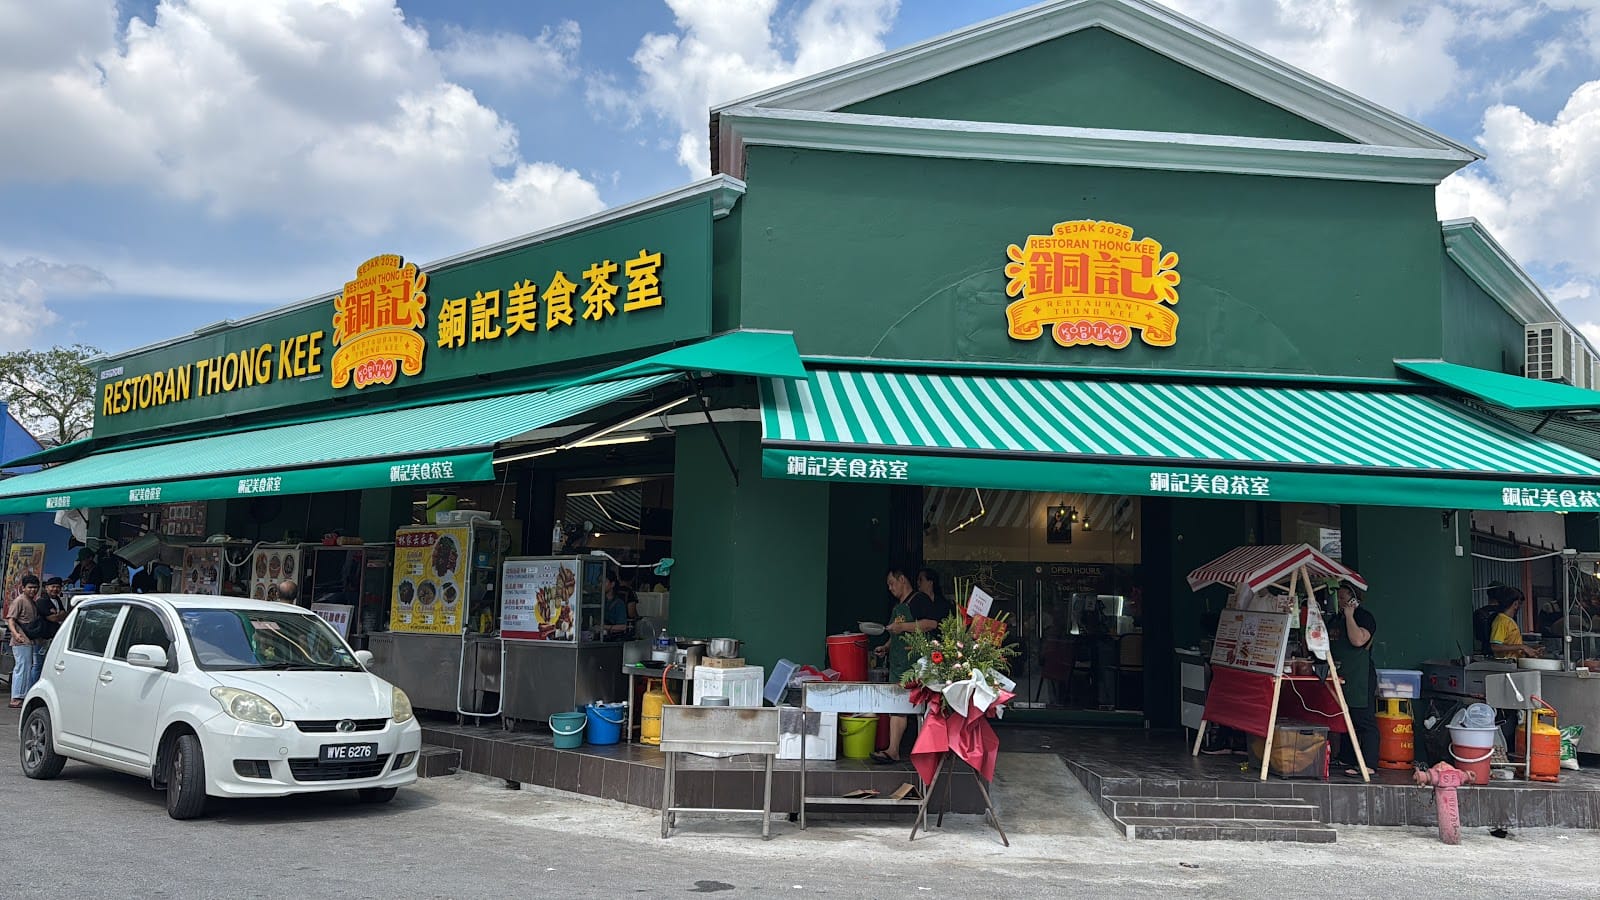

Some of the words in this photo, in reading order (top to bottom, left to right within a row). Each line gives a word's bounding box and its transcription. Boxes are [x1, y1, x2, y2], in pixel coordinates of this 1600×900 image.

[1056, 224, 1095, 236] SEJAK
[1100, 225, 1130, 239] 2025
[1030, 239, 1090, 250] RESTORAN
[1093, 240, 1132, 252] THONG
[1134, 243, 1156, 255] KEE
[358, 259, 380, 277] SEJAK
[381, 256, 399, 269] 2025
[1028, 251, 1159, 301] 銅記
[346, 275, 378, 295] RESTORAN
[378, 269, 401, 284] THONG
[401, 267, 415, 281] KEE
[437, 248, 663, 348] 銅記美食茶室
[1046, 299, 1141, 311] RESTAURANT
[343, 279, 413, 340] 銅記
[1061, 325, 1123, 337] KOPITIAM
[102, 363, 191, 417] RESTORAN
[196, 342, 272, 397] THONG
[277, 330, 324, 381] KEE
[357, 363, 393, 378] KOPITIAM
[390, 461, 455, 482] 銅記美食茶室
[787, 455, 909, 480] 銅記美食茶室
[1150, 472, 1270, 496] 銅記美食茶室
[1502, 487, 1600, 508] 銅記美食茶
[1051, 566, 1073, 575] OPEN
[327, 746, 347, 759] WVE
[347, 745, 372, 758] 6276
